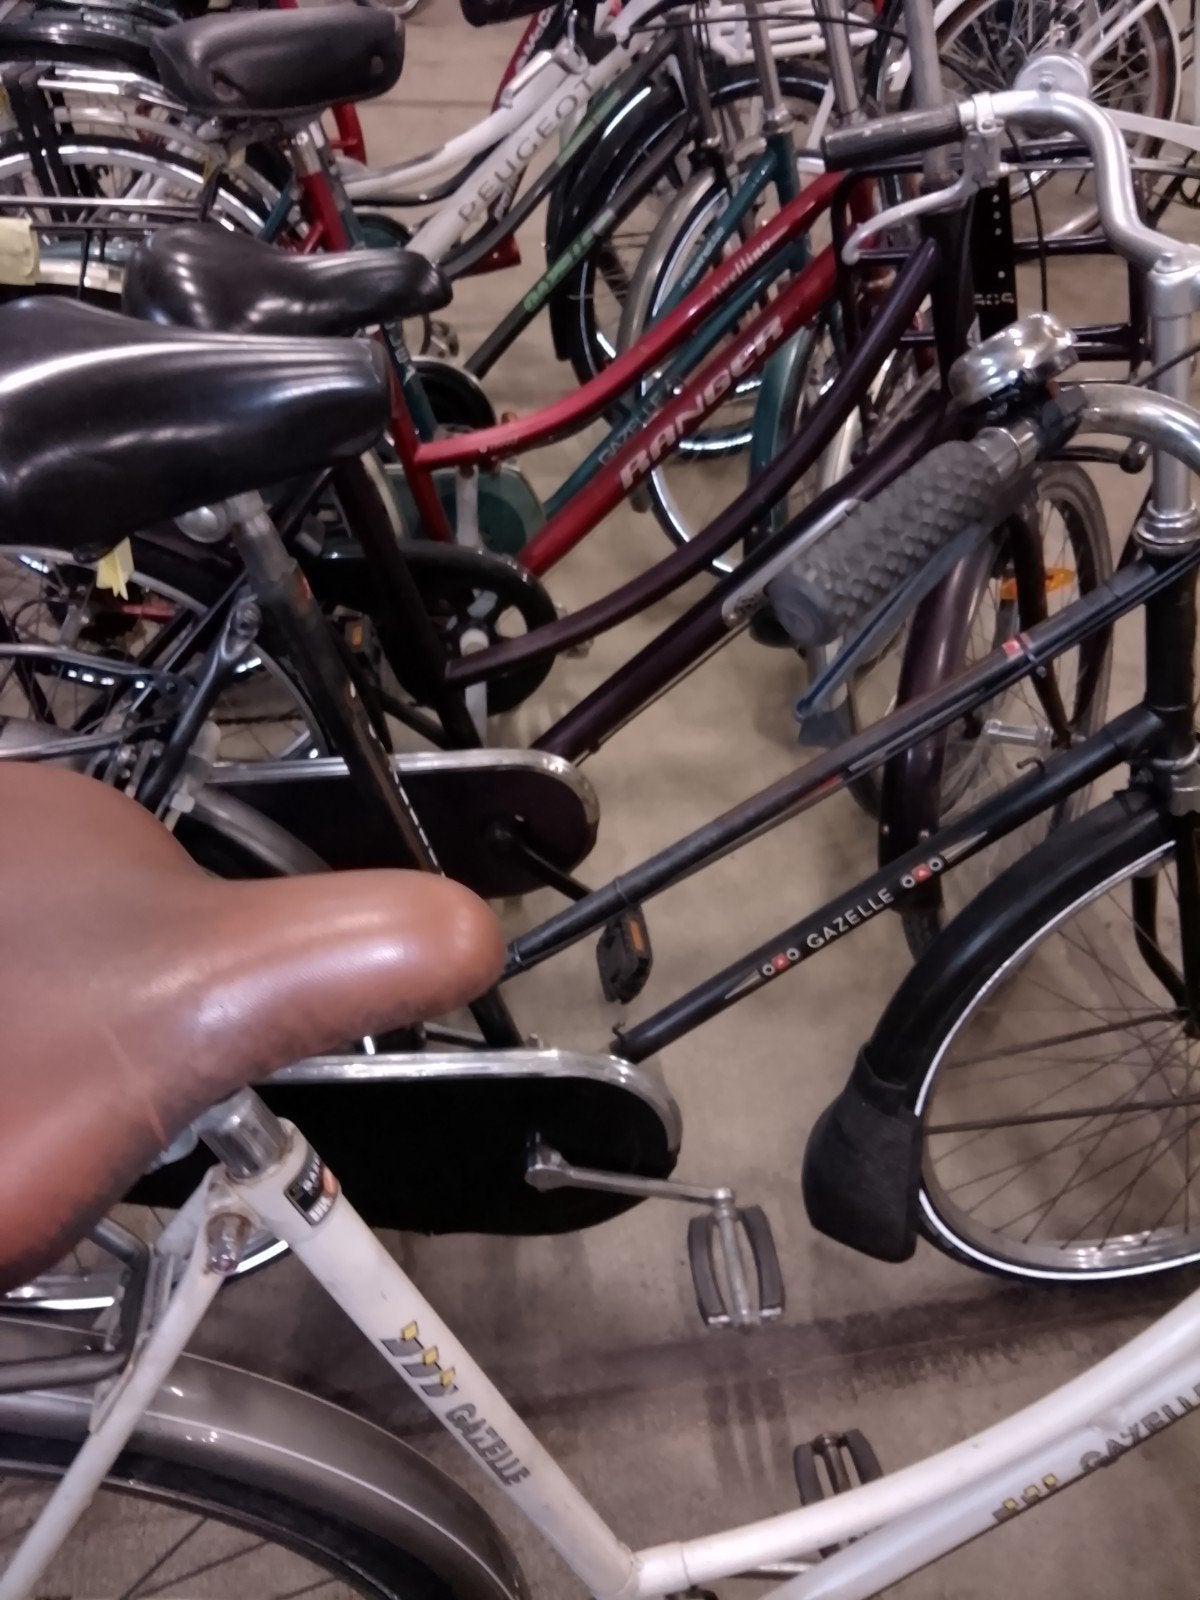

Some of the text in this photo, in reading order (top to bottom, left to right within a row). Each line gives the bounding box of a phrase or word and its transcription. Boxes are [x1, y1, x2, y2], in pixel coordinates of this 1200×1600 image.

[458, 76, 592, 222] PEUGEOT
[620, 317, 782, 489] RANGER
[806, 887, 895, 949] GAZELLE
[445, 1403, 531, 1486] GAZELLE
